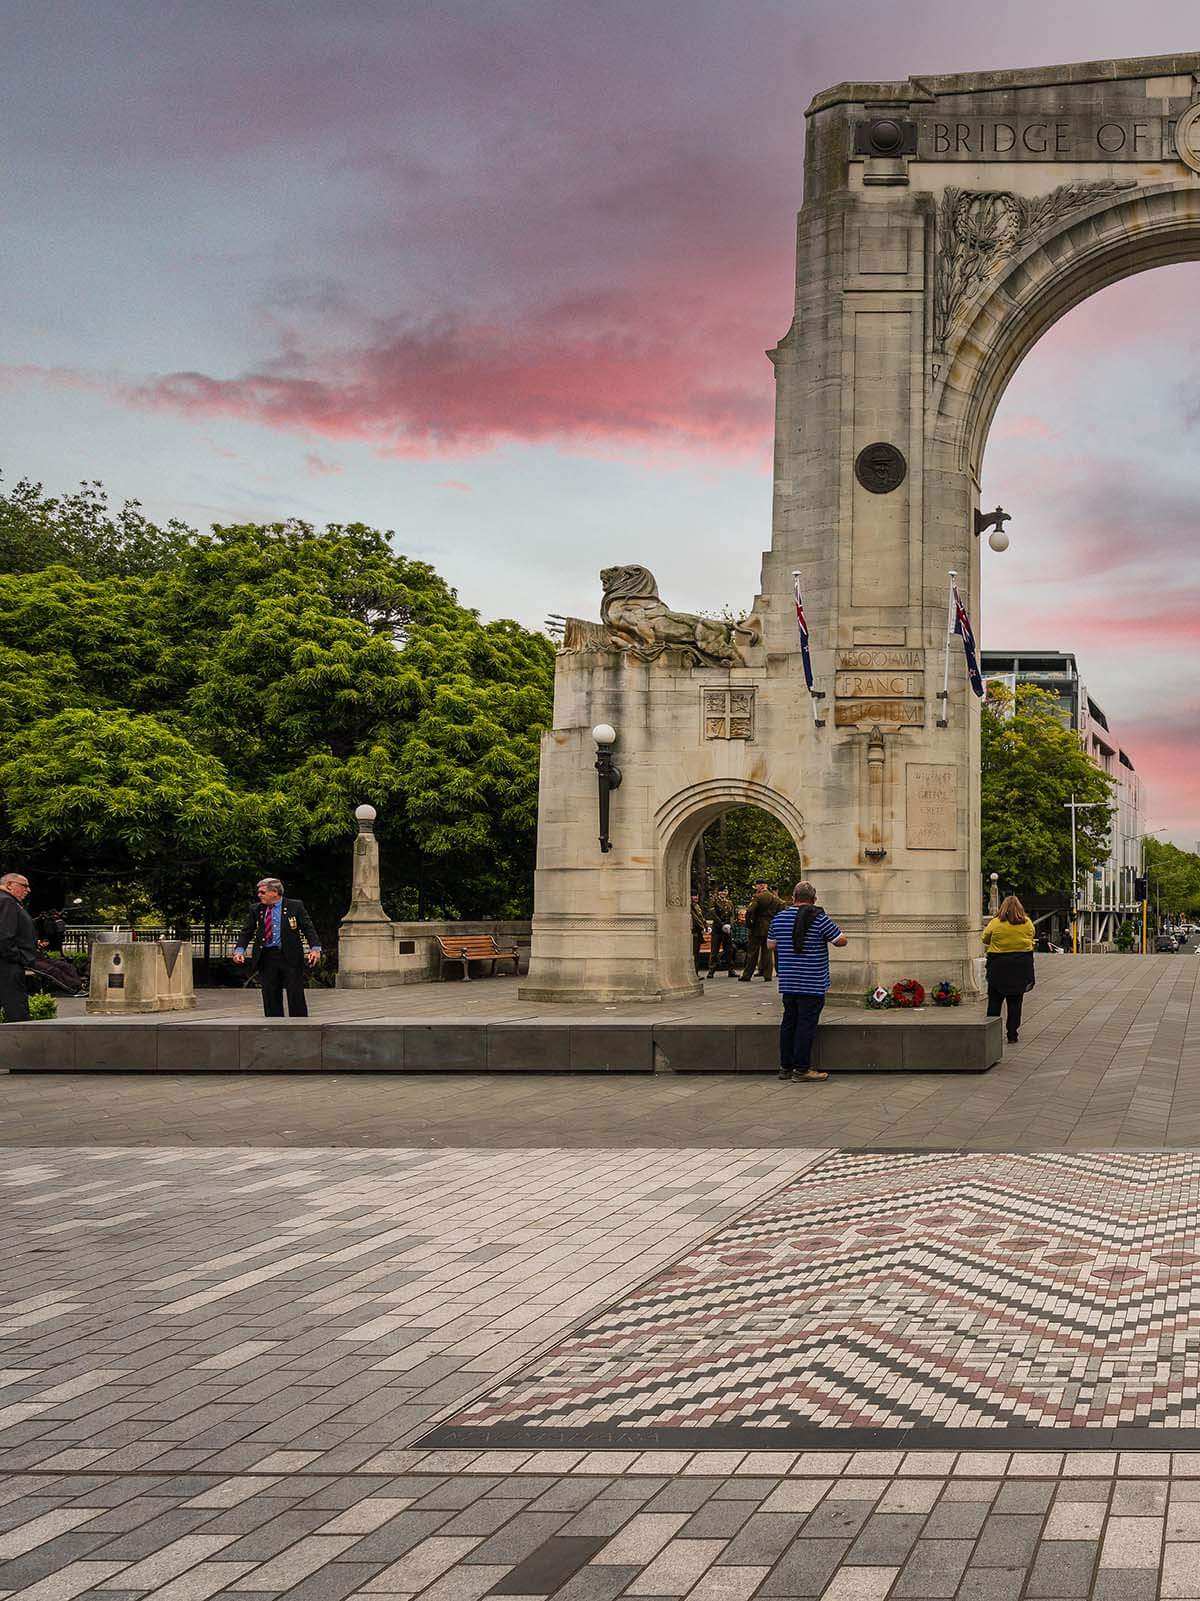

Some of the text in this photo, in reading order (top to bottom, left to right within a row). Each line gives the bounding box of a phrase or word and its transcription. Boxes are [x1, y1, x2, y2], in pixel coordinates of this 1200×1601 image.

[934, 123, 1071, 153] BRIDGE
[1096, 123, 1149, 153] OF
[845, 677, 914, 694] FRANCE
